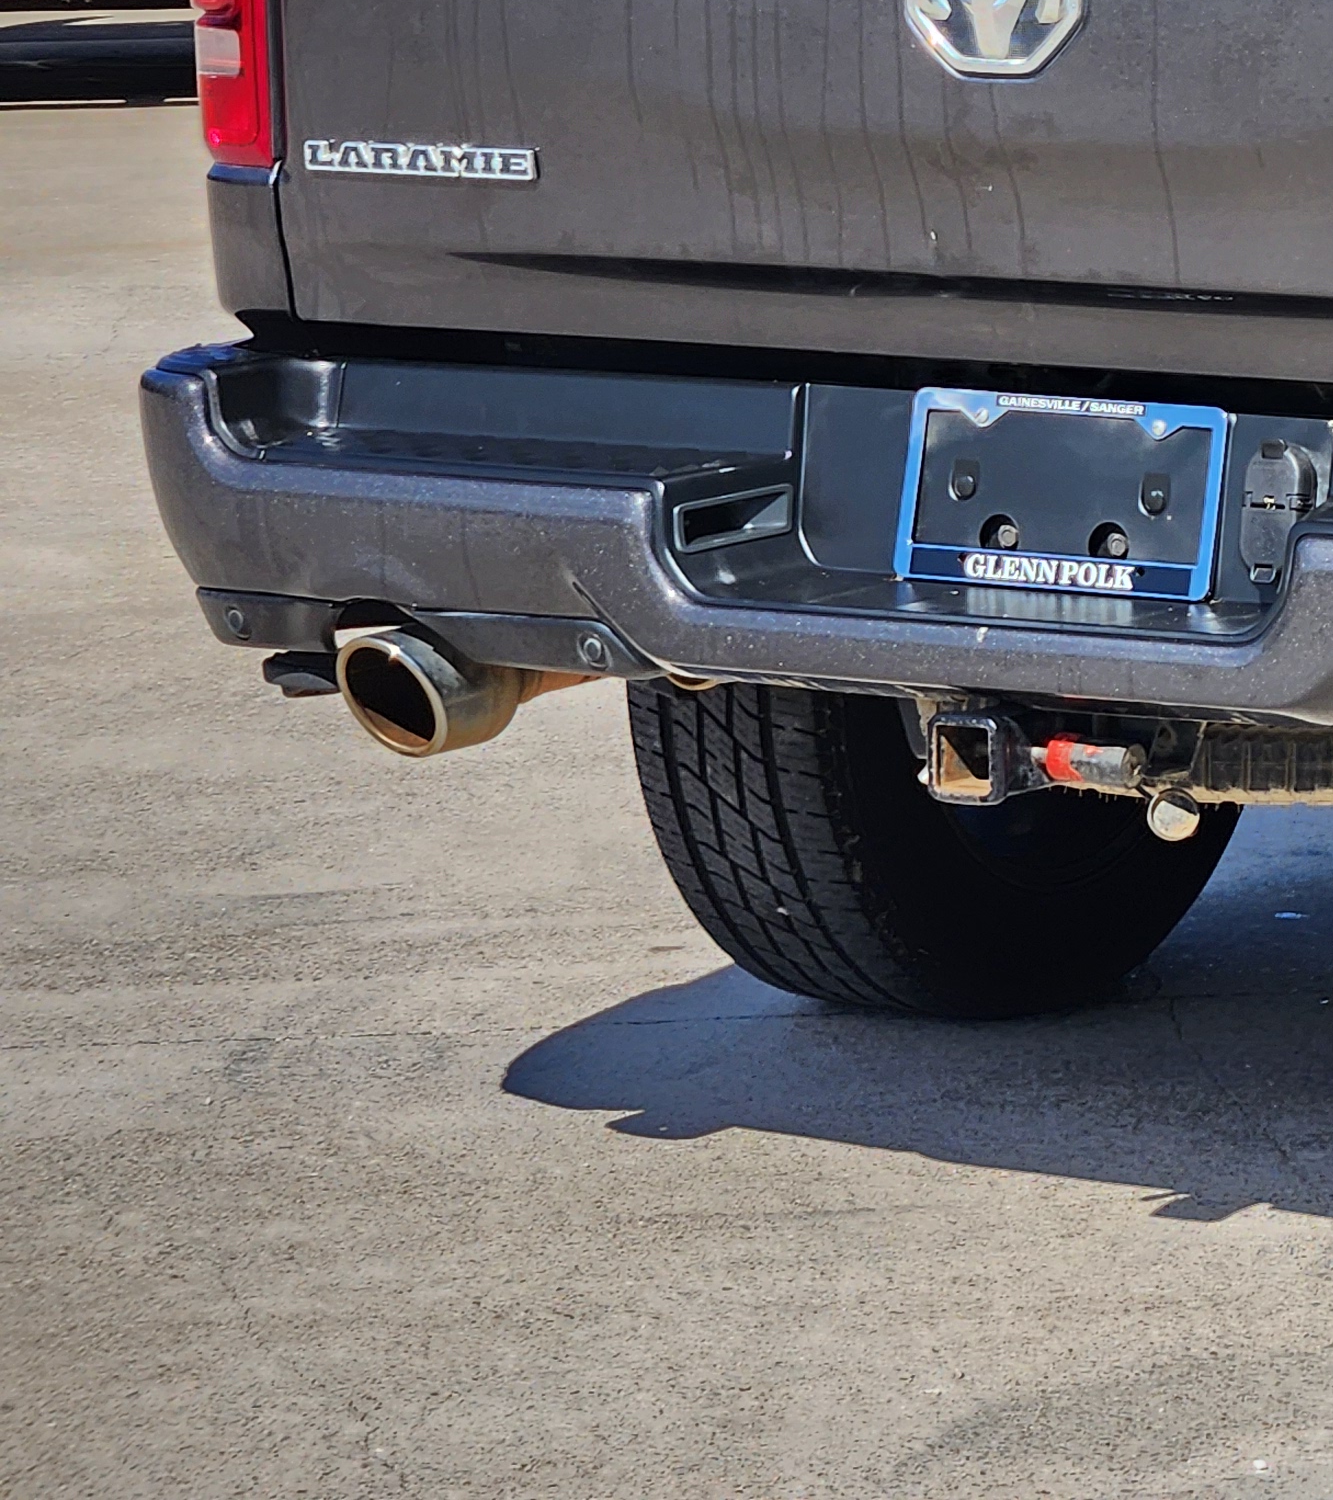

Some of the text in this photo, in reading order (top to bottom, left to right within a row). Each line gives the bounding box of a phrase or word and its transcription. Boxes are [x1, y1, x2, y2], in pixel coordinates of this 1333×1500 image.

[305, 141, 534, 180] LARAMIE
[965, 553, 1136, 591] GLENN POLK
